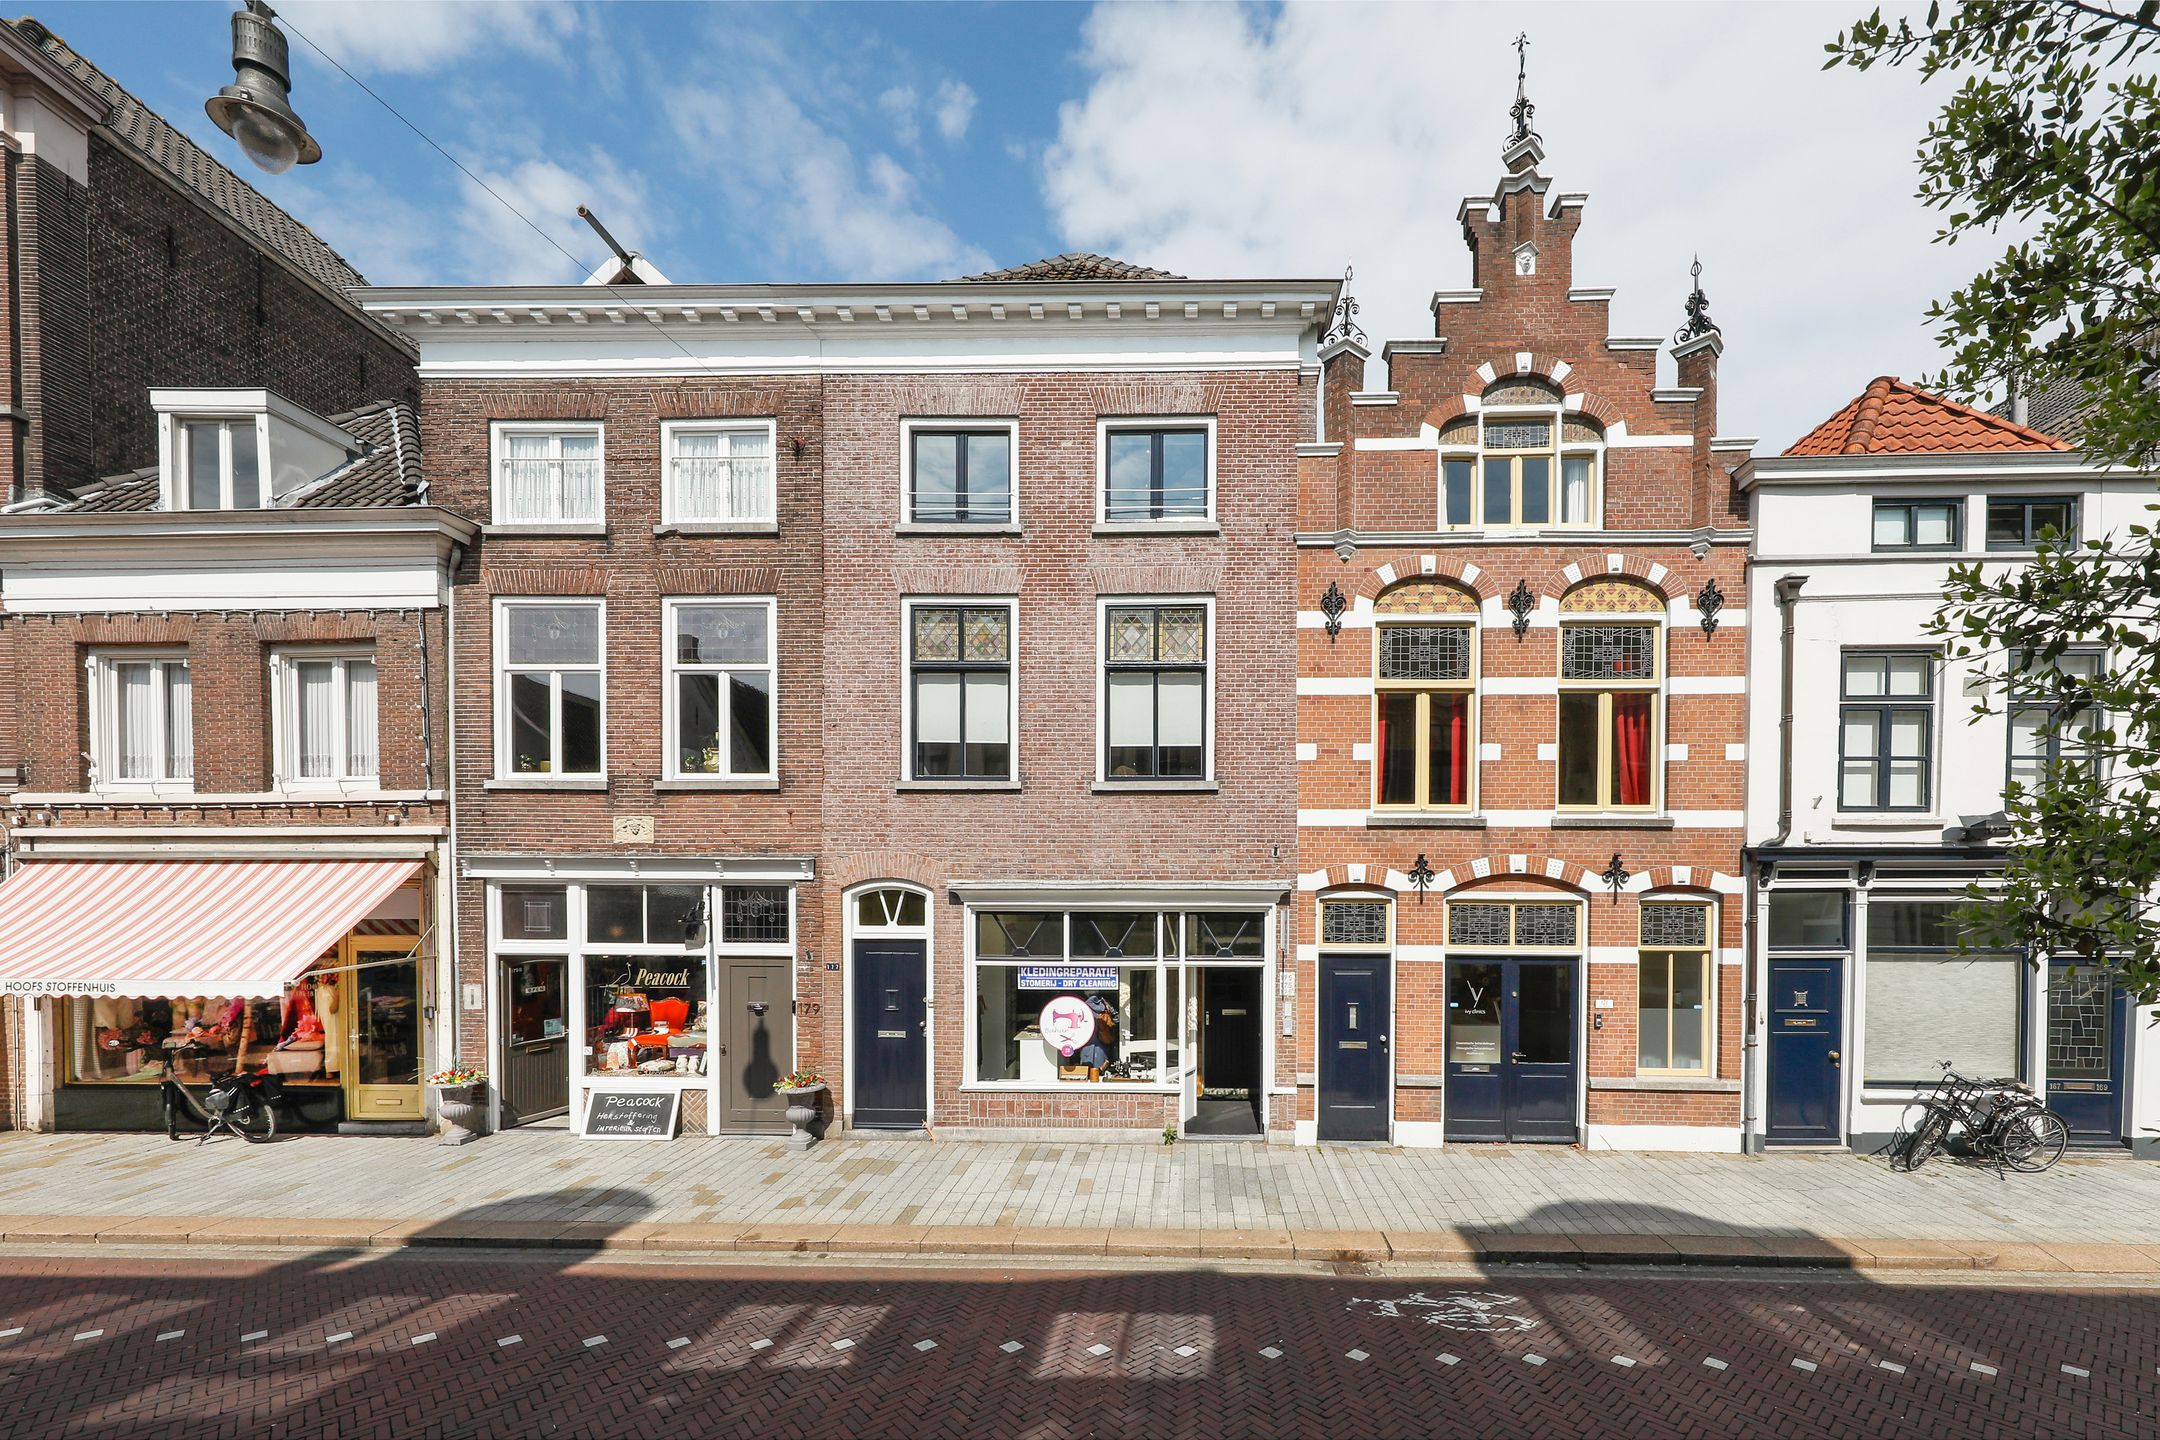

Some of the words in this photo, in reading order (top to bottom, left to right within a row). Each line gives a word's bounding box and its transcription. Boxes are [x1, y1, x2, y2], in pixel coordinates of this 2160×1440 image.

[635, 969, 690, 986] Peacock
[1021, 967, 1116, 977] KLEDINGREPARATIE
[5, 981, 43, 991] HOOFS
[46, 982, 116, 992] STOFFENHUIS
[799, 1003, 820, 1015] 179
[2096, 1083, 2108, 1091] 169
